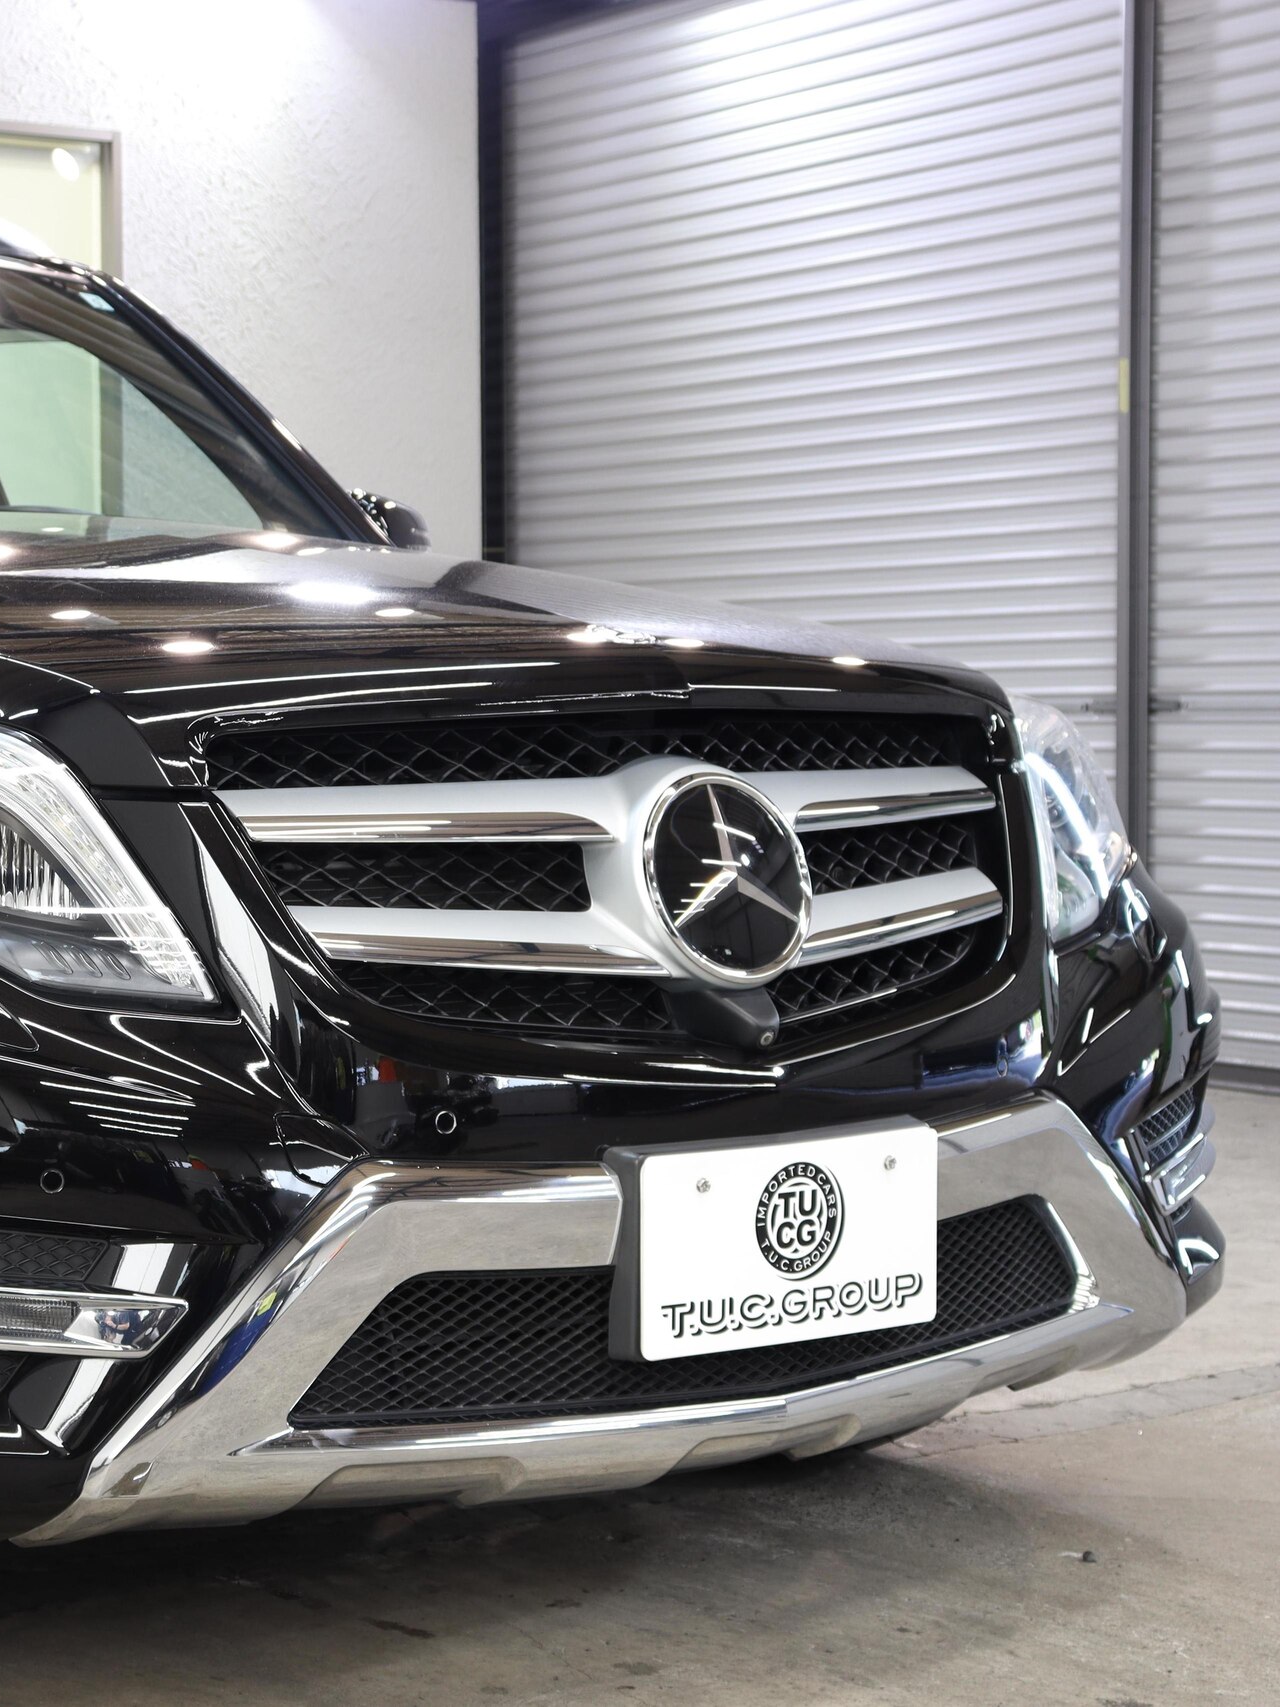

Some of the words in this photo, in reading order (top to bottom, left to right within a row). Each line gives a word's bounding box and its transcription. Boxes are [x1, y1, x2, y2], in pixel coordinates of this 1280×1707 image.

[757, 1163, 816, 1227] IMPORTED
[817, 1173, 837, 1218] CARS
[760, 1230, 832, 1272] T.U.C.GROUP
[661, 1272, 923, 1338] T.U.C.GROUP
